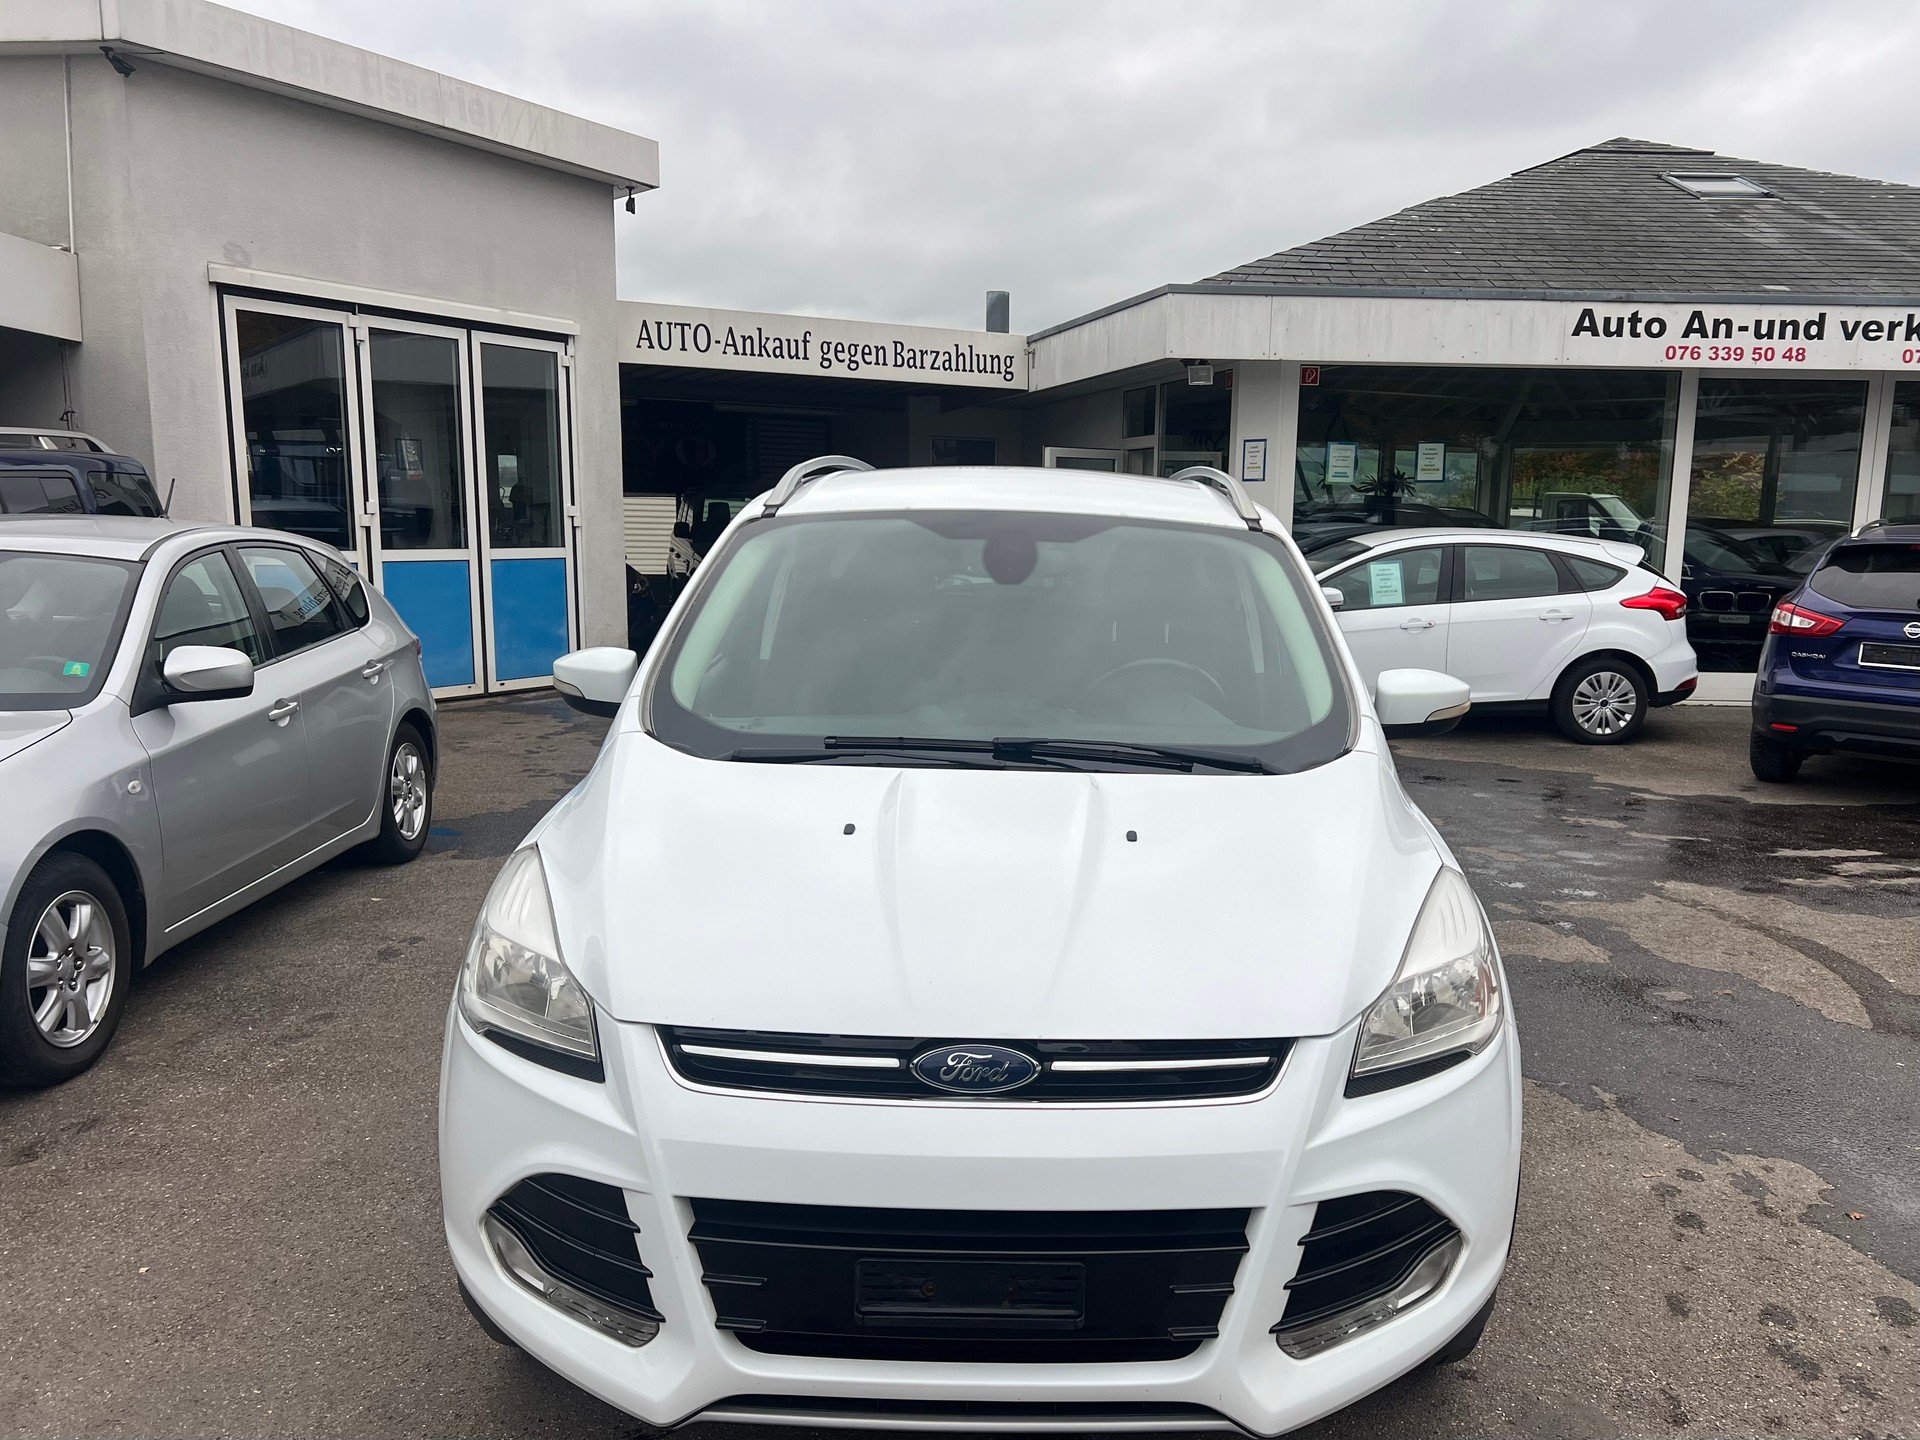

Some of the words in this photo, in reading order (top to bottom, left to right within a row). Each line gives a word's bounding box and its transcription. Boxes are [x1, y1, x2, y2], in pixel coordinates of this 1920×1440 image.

[1571, 308, 1667, 339] Auto
[1681, 310, 1827, 341] An-und
[1840, 313, 1920, 342] verk
[636, 319, 811, 361] AUTO-Ankauf
[820, 340, 888, 371] gegen
[892, 341, 1015, 382] Barzahlung
[1665, 345, 1702, 361] 076
[1708, 345, 1745, 362] 339
[1751, 346, 1776, 362] 50
[1782, 347, 1807, 363] 48
[939, 1052, 1011, 1082] Ford
